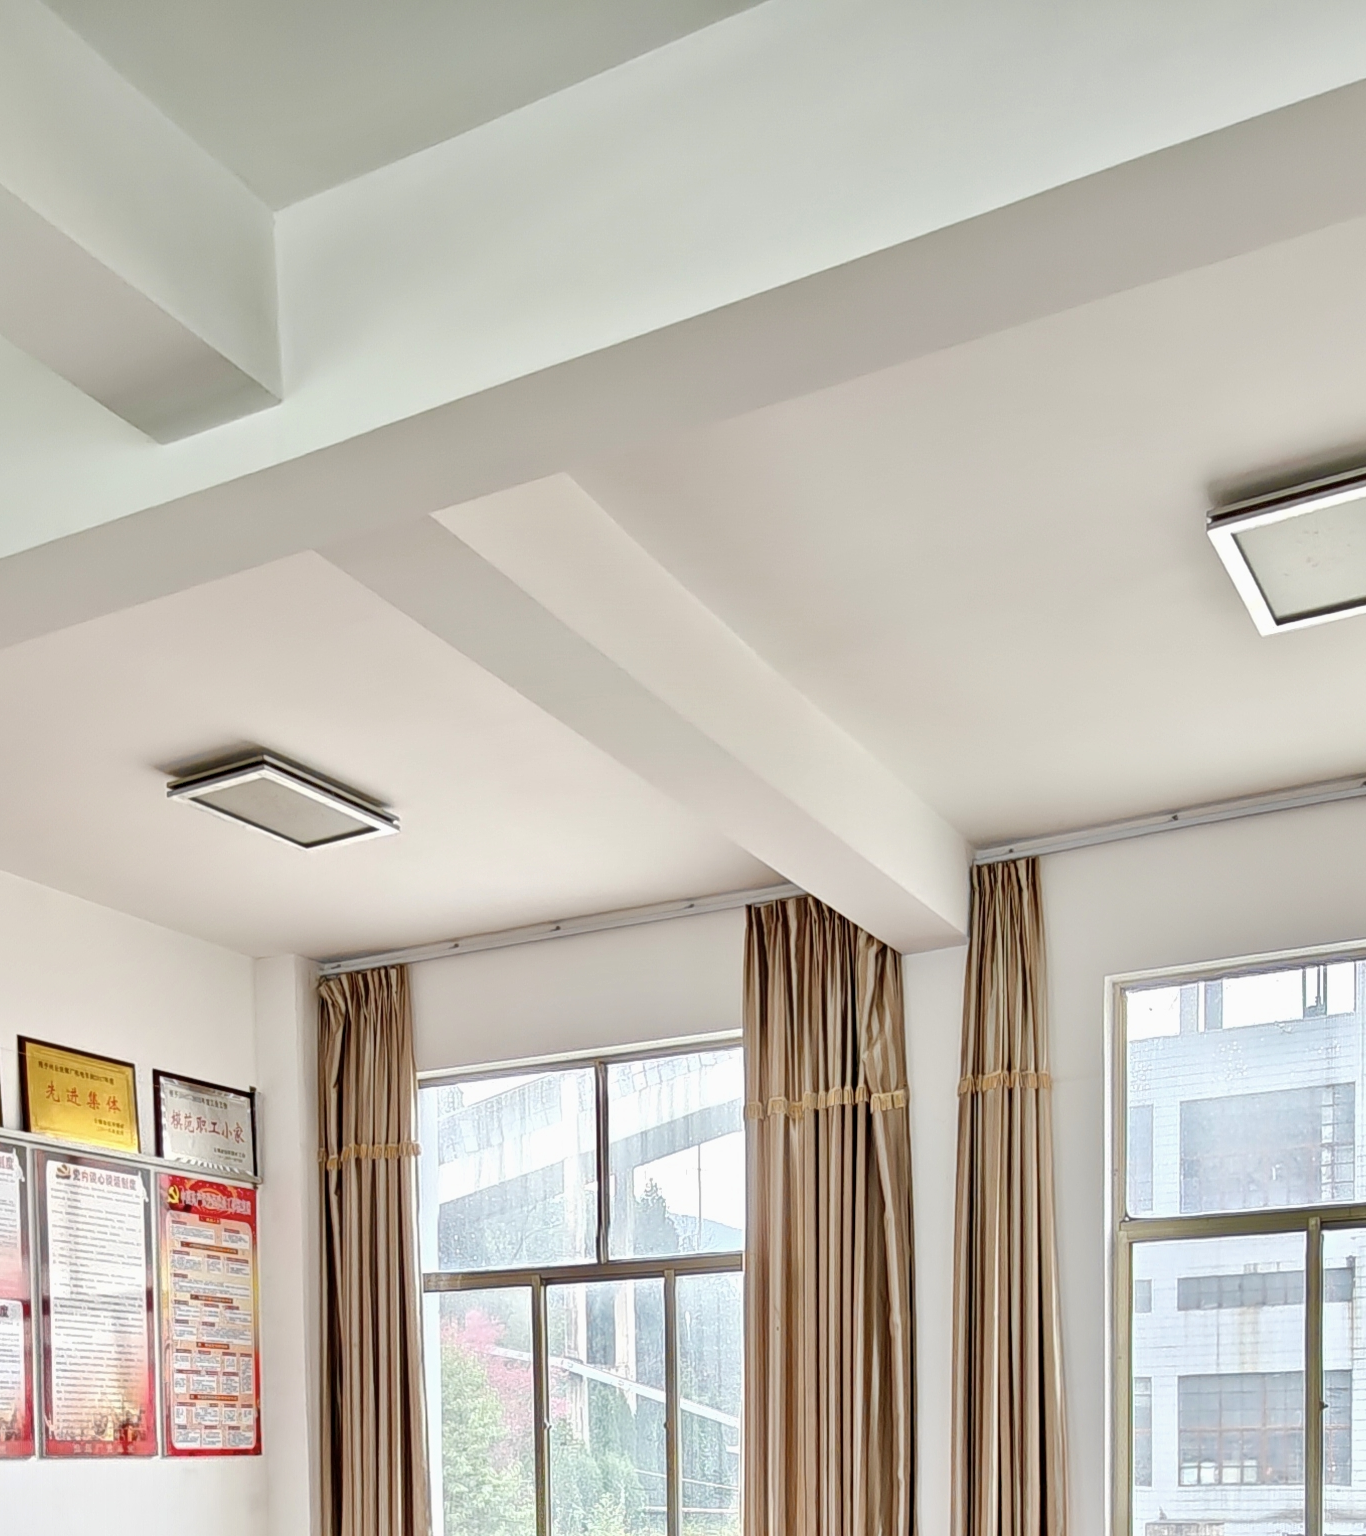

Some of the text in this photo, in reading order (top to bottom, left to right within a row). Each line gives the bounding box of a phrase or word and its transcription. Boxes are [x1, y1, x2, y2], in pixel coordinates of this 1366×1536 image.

[45, 1080, 122, 1114] 先进集体
[170, 1109, 245, 1144] 模范职工小家
